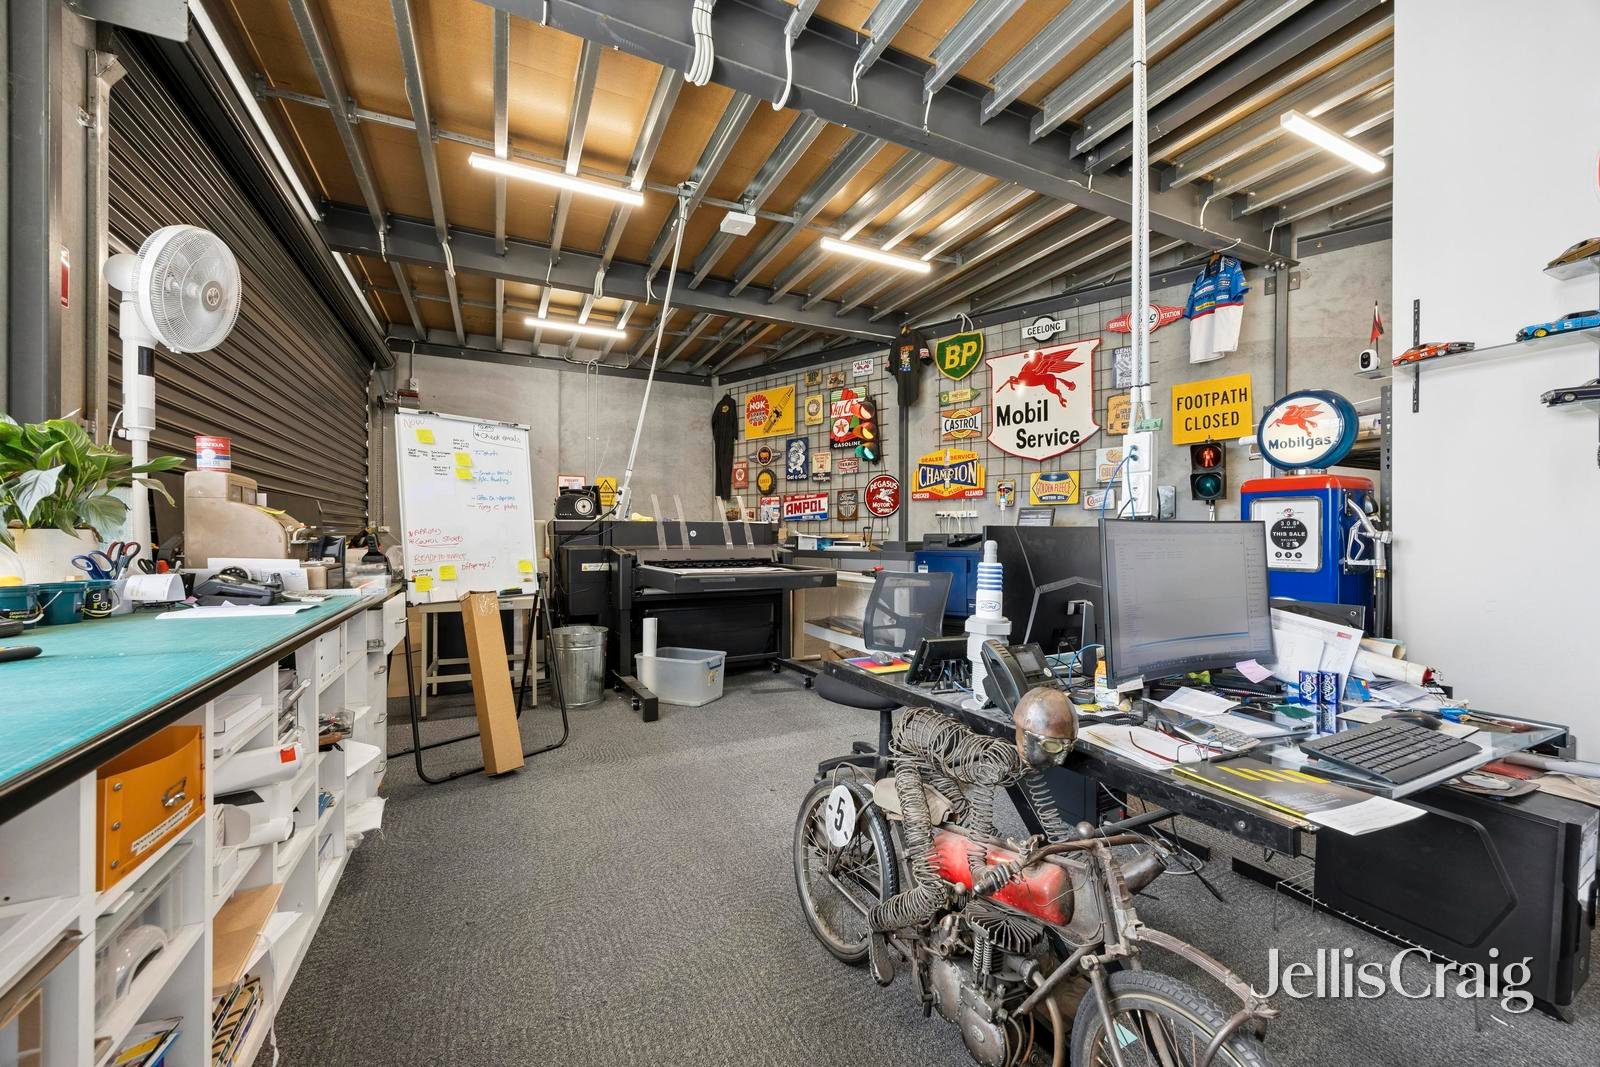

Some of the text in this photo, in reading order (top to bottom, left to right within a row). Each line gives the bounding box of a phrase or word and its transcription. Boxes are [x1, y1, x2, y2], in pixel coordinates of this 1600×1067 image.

[1027, 322, 1061, 336] GEELONG
[1109, 309, 1181, 329] SERVICE STATION
[944, 341, 977, 369] BP
[750, 400, 766, 411] NGK
[1176, 387, 1248, 411] FOOTPATH
[996, 399, 1049, 427] Mobil
[1185, 411, 1239, 431] CLOSED
[944, 416, 979, 432] CASTROL
[833, 440, 861, 449] GASOLINE
[1016, 428, 1080, 449] Service
[1268, 436, 1332, 451] Mobilgas
[919, 461, 977, 487] CHAMPION
[870, 480, 898, 493] PEGASUS
[1036, 480, 1071, 494] GOLDEN FLEECE
[840, 493, 856, 501] Ford
[786, 500, 825, 516] AMPOL
[1302, 674, 1315, 701] eclipse
[1322, 674, 1334, 701] eclipse
[834, 796, 846, 831] 5
